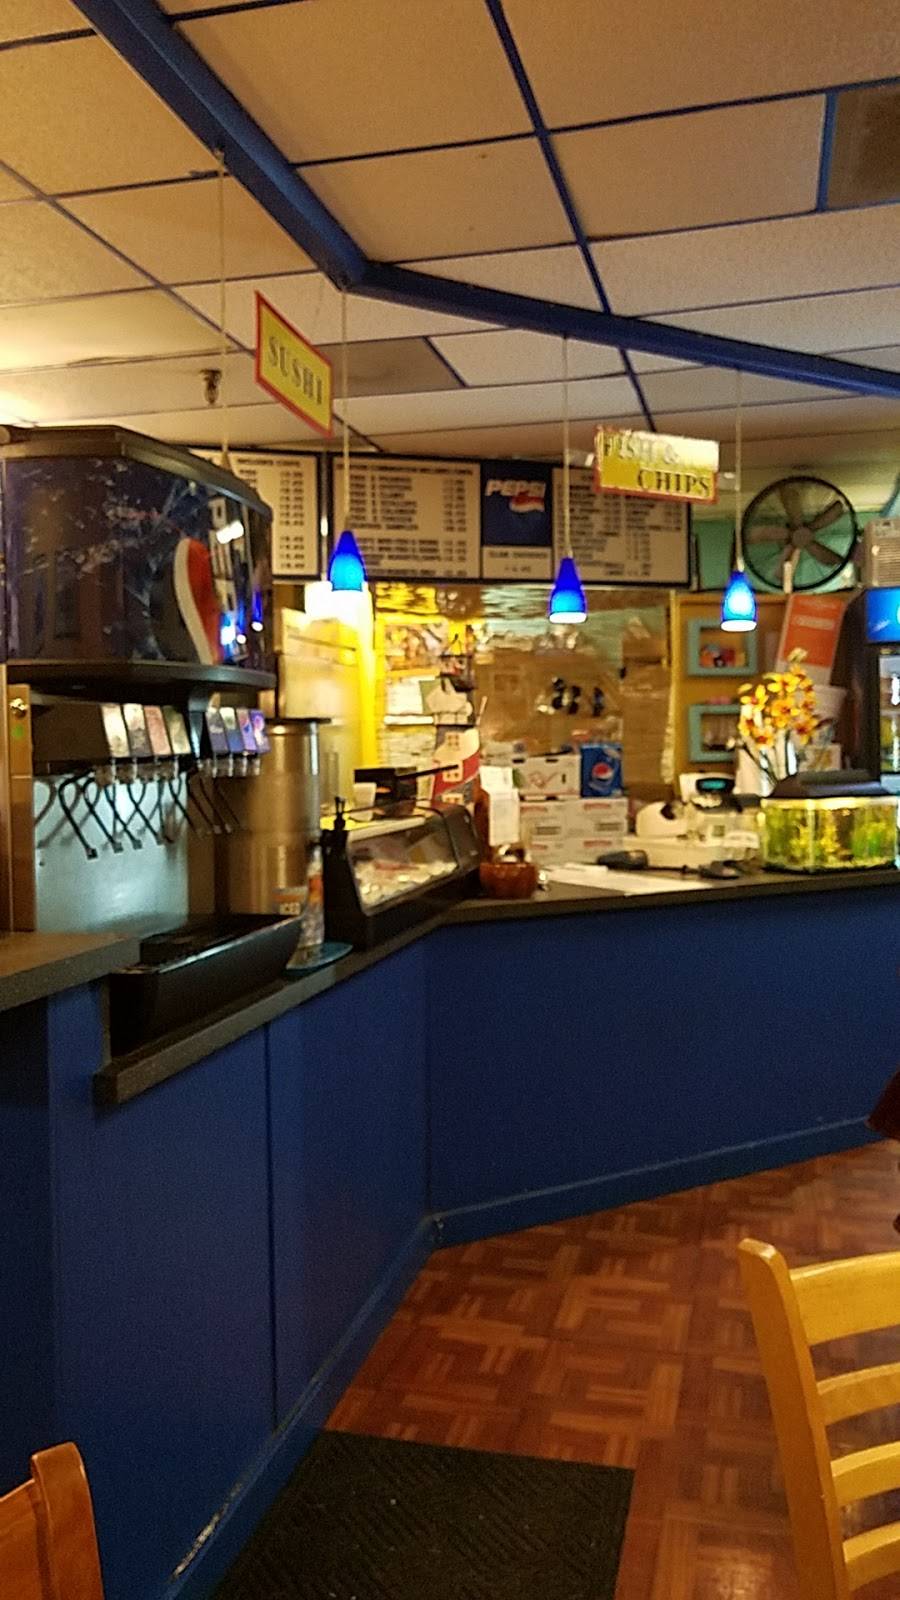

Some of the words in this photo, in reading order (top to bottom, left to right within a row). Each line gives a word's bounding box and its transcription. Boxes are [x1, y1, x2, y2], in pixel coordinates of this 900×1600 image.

[268, 335, 323, 406] SUSHI
[603, 433, 656, 465] FISH
[663, 442, 681, 465] &
[484, 478, 546, 498] PEPSI
[637, 469, 710, 498] CHIPS
